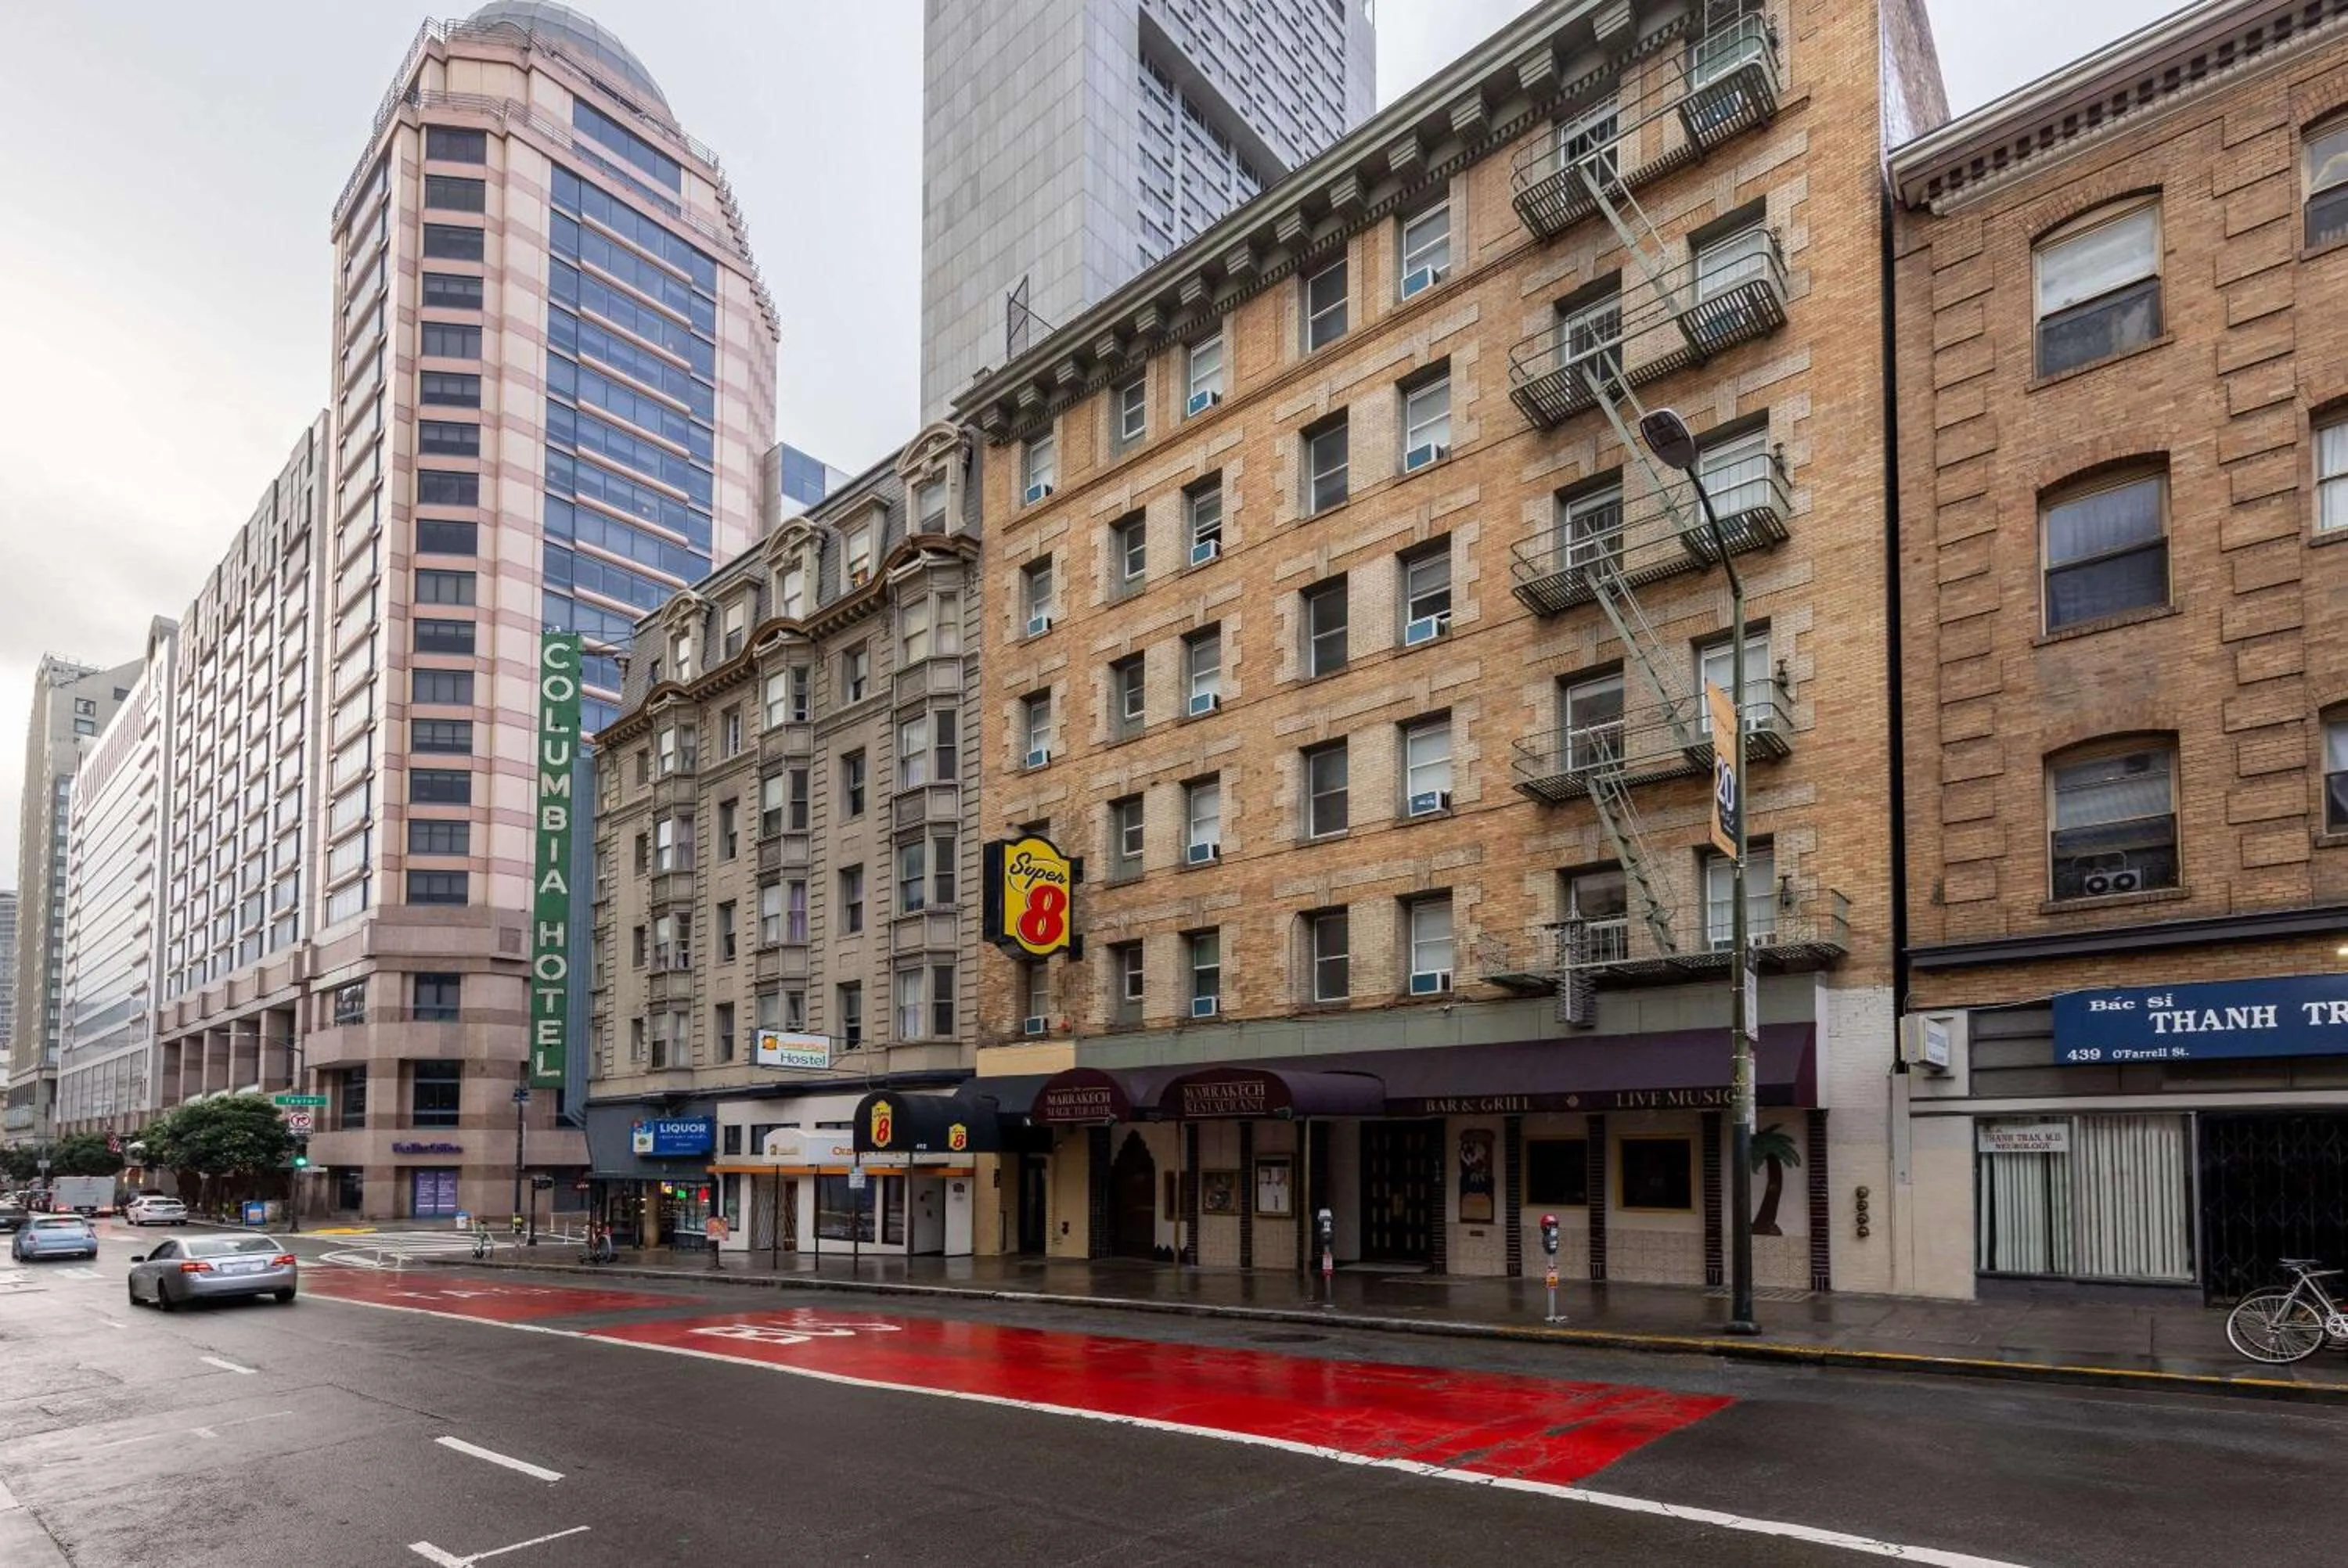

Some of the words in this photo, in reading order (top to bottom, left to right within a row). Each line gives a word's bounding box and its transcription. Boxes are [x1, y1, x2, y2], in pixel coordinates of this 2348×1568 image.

[539, 642, 574, 894] COLUMBIA
[1009, 851, 1068, 889] Super
[1017, 884, 1067, 945] 8
[535, 921, 567, 1077] HOTEL
[2089, 996, 2136, 1012] Bác
[2148, 1004, 2278, 1034] THANH
[780, 1052, 826, 1066] Hostel
[2067, 1048, 2101, 1060] 439
[2112, 1048, 2167, 1059] O'Farrell
[2171, 1046, 2190, 1056] St.
[1047, 1092, 1111, 1105] MARRAKECH
[1183, 1084, 1265, 1098] MARRAKECH
[1616, 1092, 1662, 1107] LIVE
[1666, 1088, 1735, 1106] MUSIC
[1426, 1099, 1459, 1112] BAR
[1460, 1100, 1473, 1112] &
[1480, 1097, 1534, 1111] GRILL
[659, 1123, 708, 1134] LIQUOR
[877, 1117, 890, 1142] 8
[953, 1135, 965, 1148] 8
